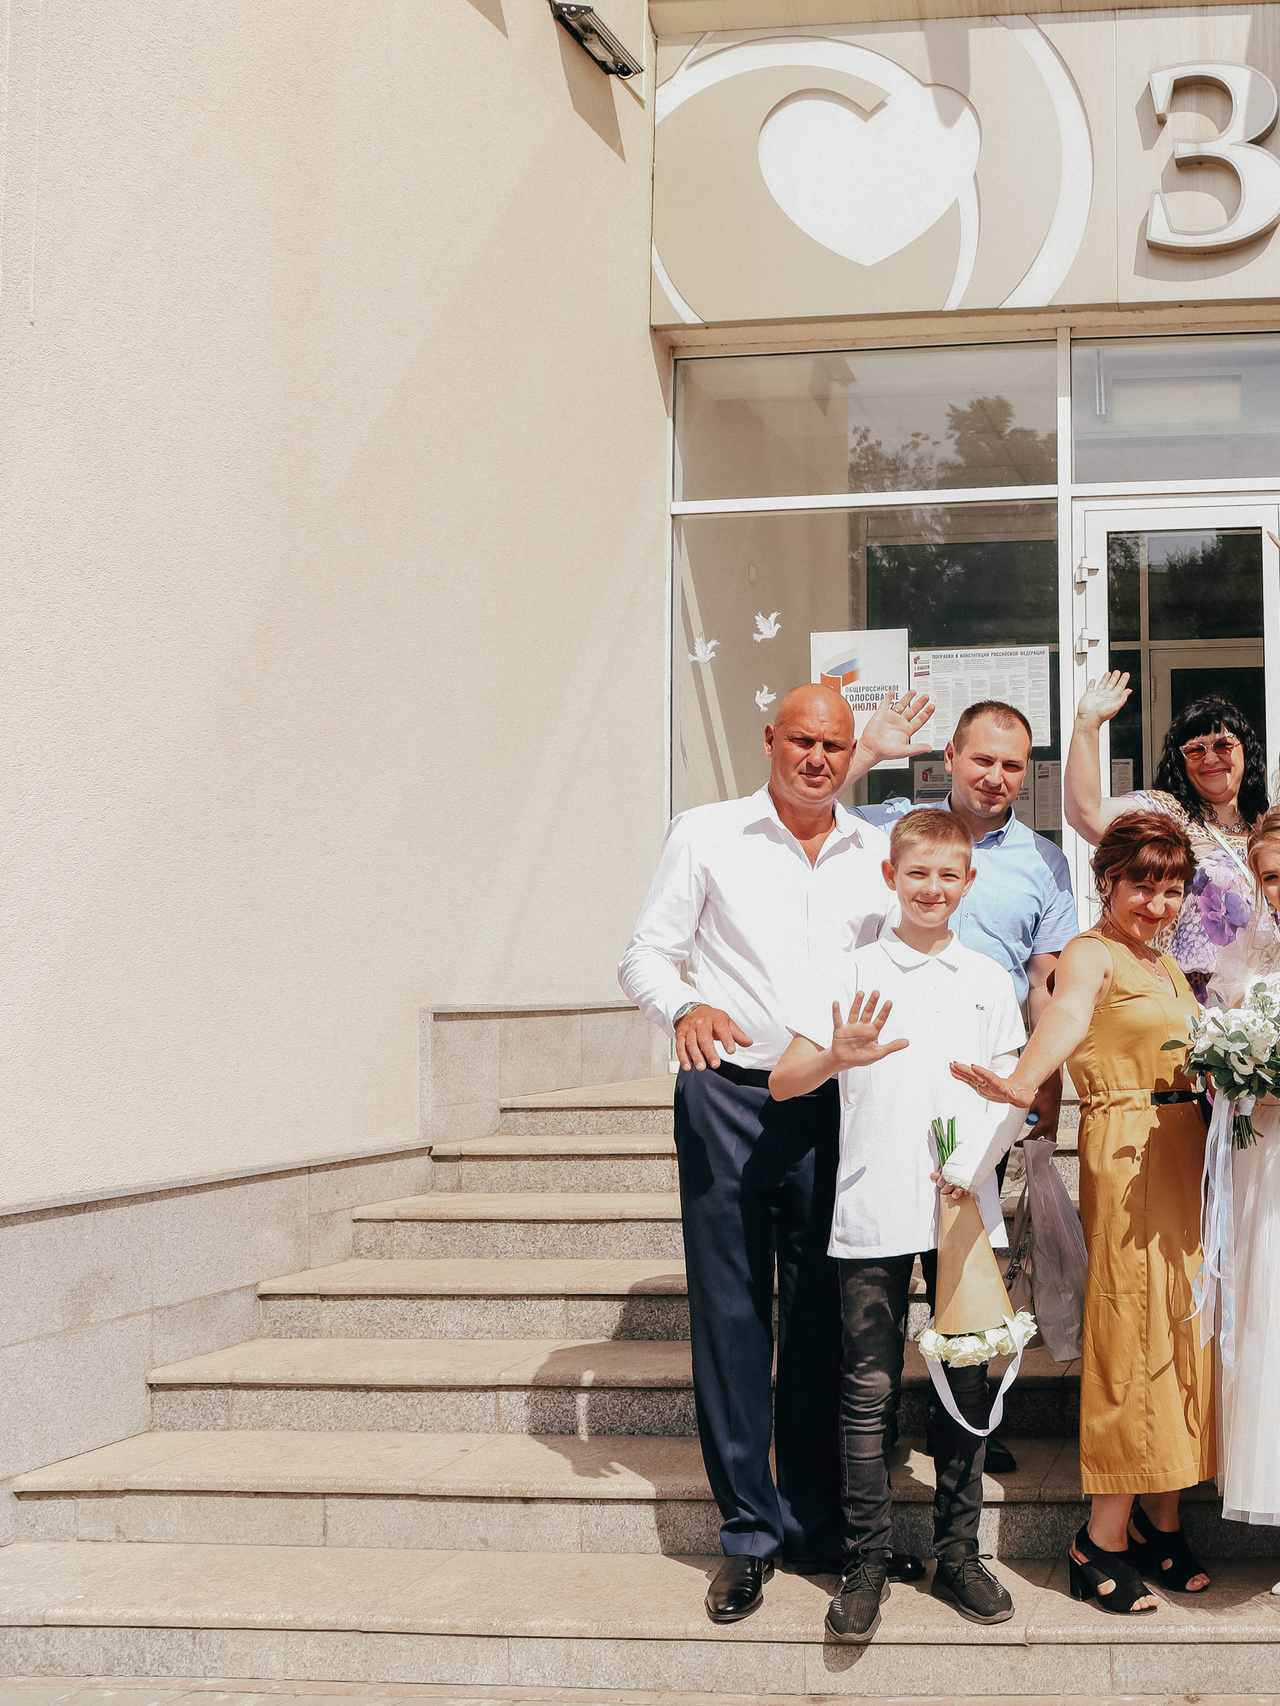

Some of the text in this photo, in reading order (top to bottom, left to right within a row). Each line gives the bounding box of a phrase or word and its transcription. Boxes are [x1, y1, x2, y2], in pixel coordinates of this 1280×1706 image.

[845, 684, 899, 693] ОБЩЕРОССИЙСКОЕ
[845, 692, 899, 702] ГОЛОСОВАЕ
[853, 702, 877, 711] ИЮЛЯ
